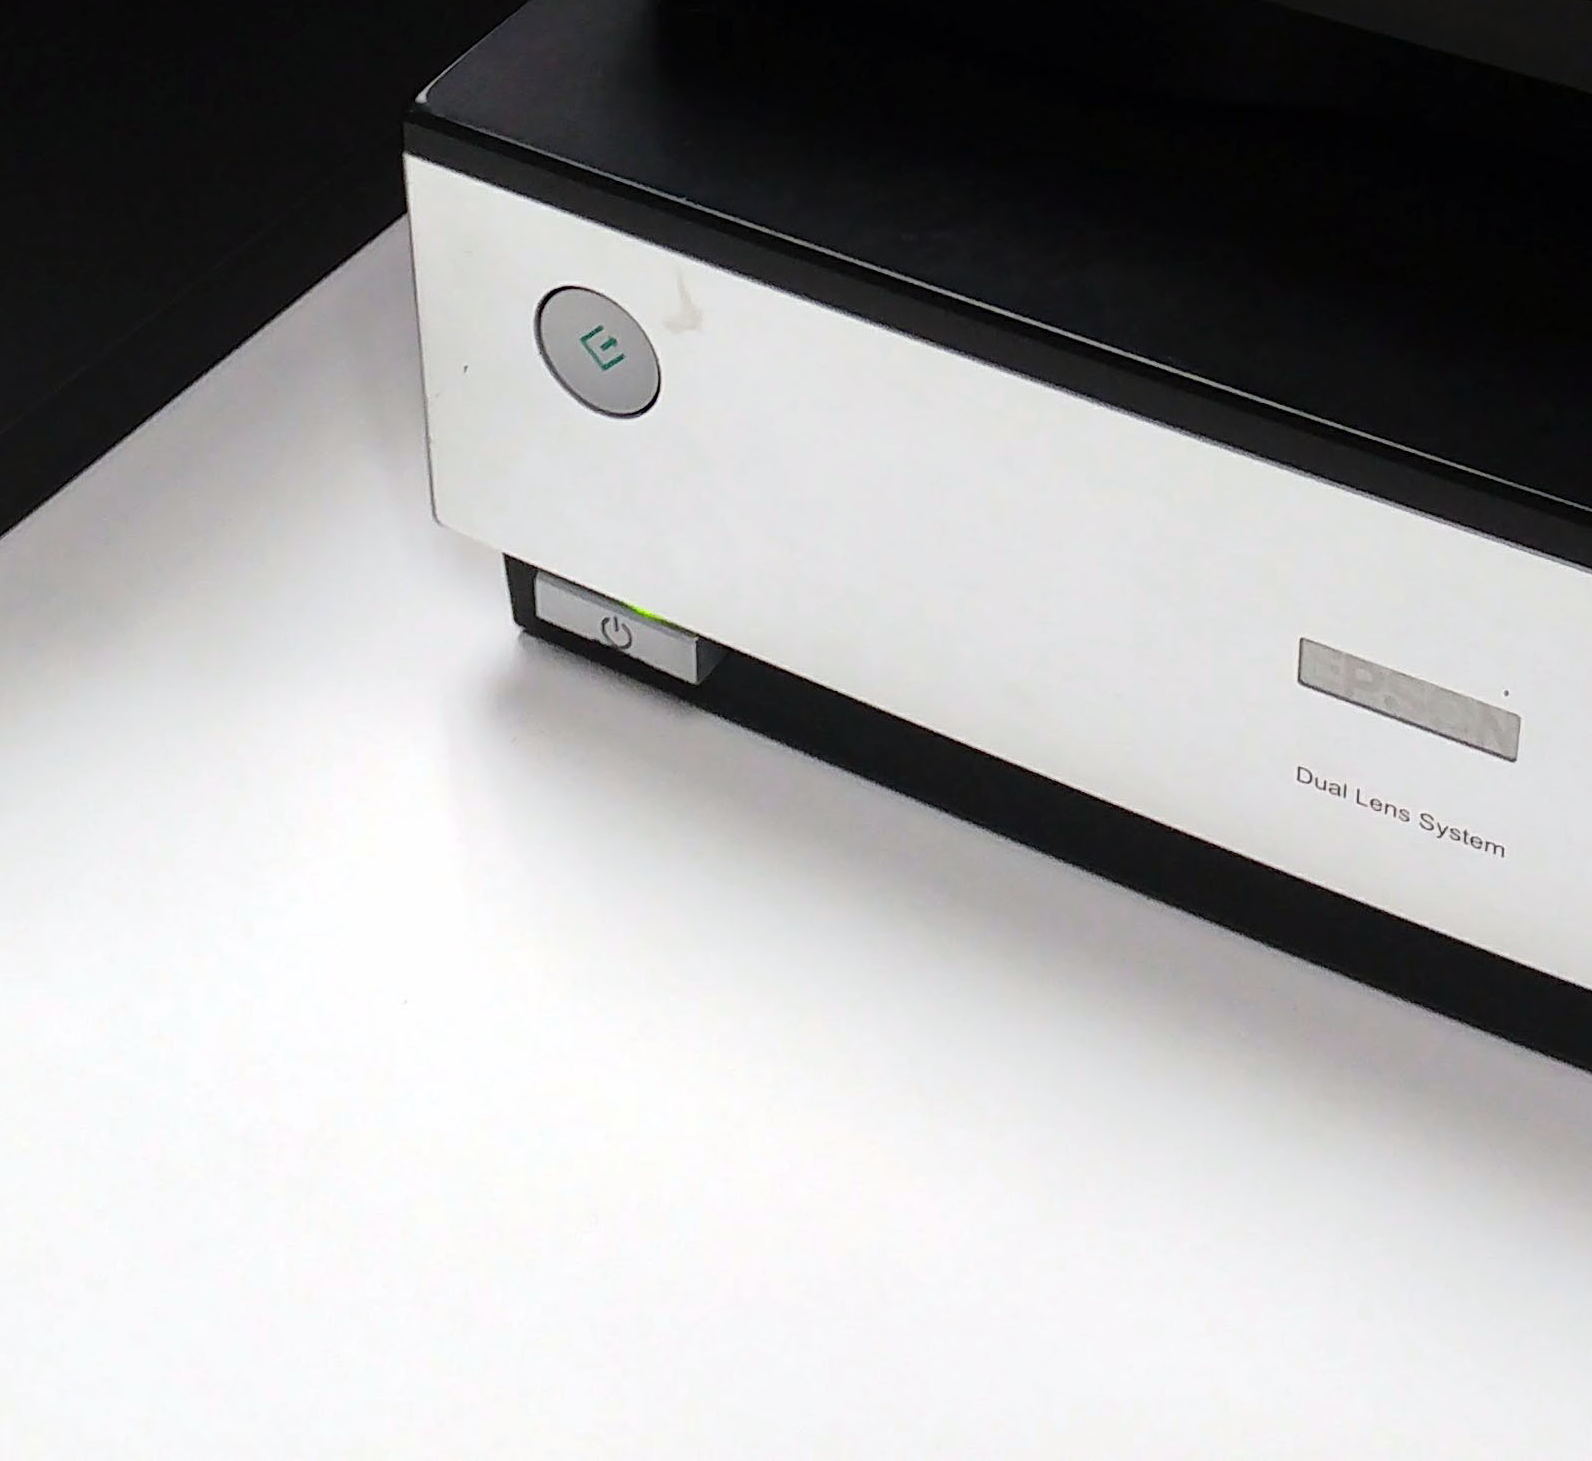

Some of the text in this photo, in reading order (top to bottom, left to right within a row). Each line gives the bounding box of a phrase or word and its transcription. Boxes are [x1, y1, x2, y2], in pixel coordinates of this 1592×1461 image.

[1295, 765, 1506, 859] Dual Lens System
